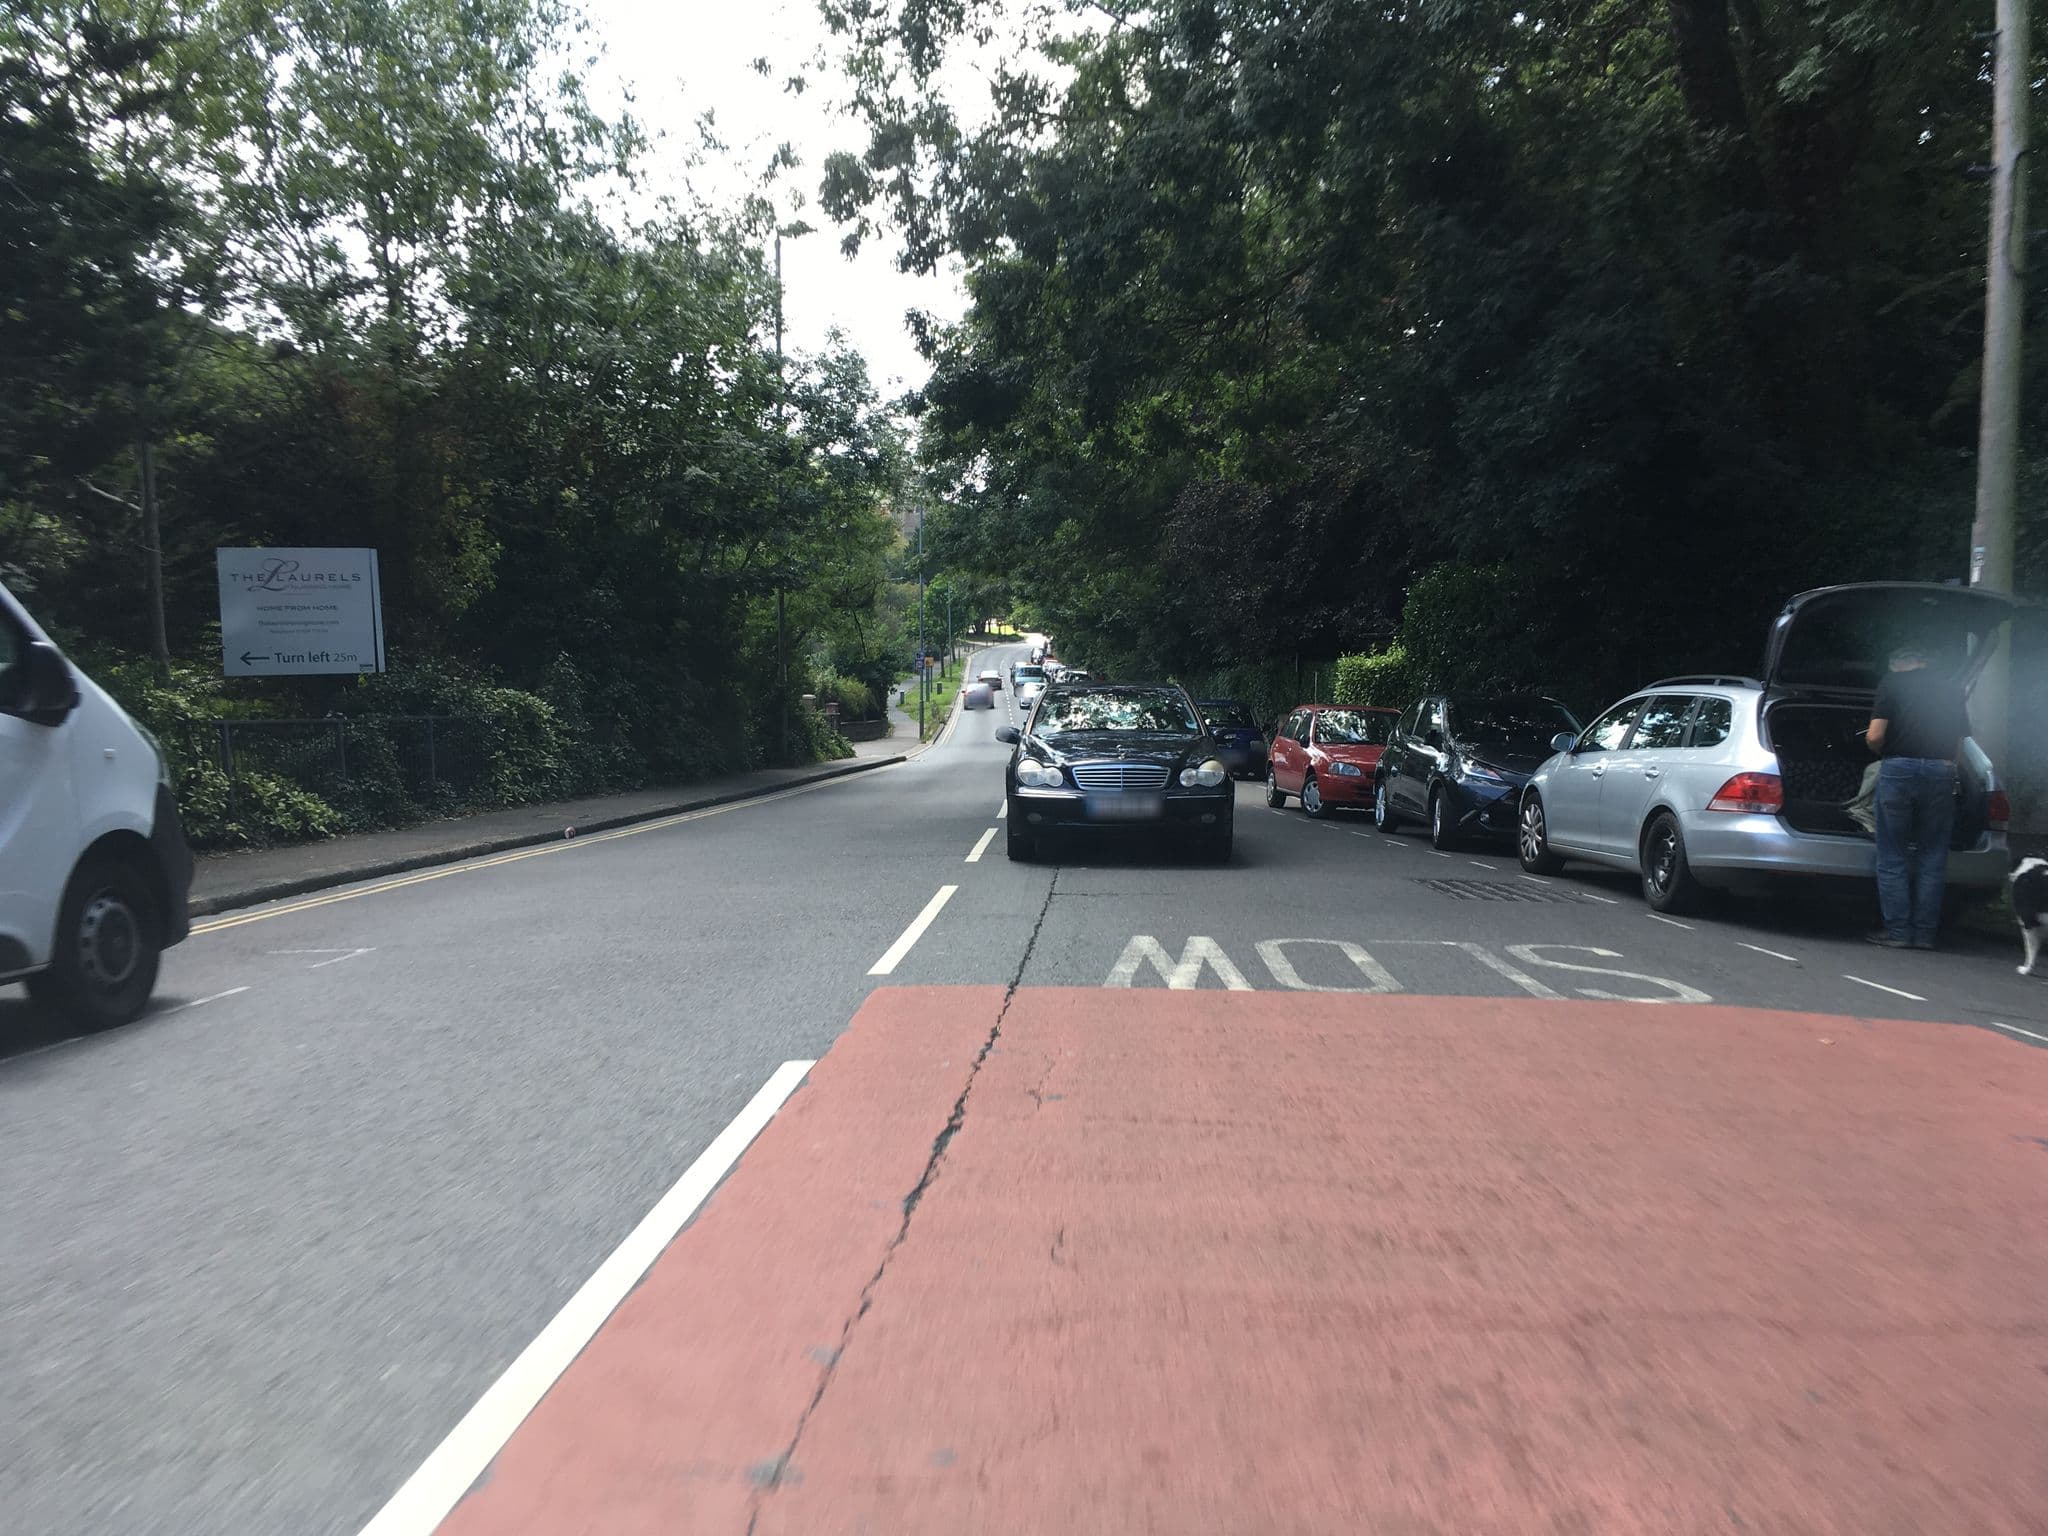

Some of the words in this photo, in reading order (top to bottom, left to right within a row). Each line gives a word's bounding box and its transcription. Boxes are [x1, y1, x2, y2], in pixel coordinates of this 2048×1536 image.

[231, 573, 266, 583] THE
[276, 573, 361, 583] LAURELS
[275, 652, 305, 664] Turn
[308, 651, 331, 663] left
[334, 654, 358, 663] 25m
[1101, 935, 1714, 1006] SLOW
